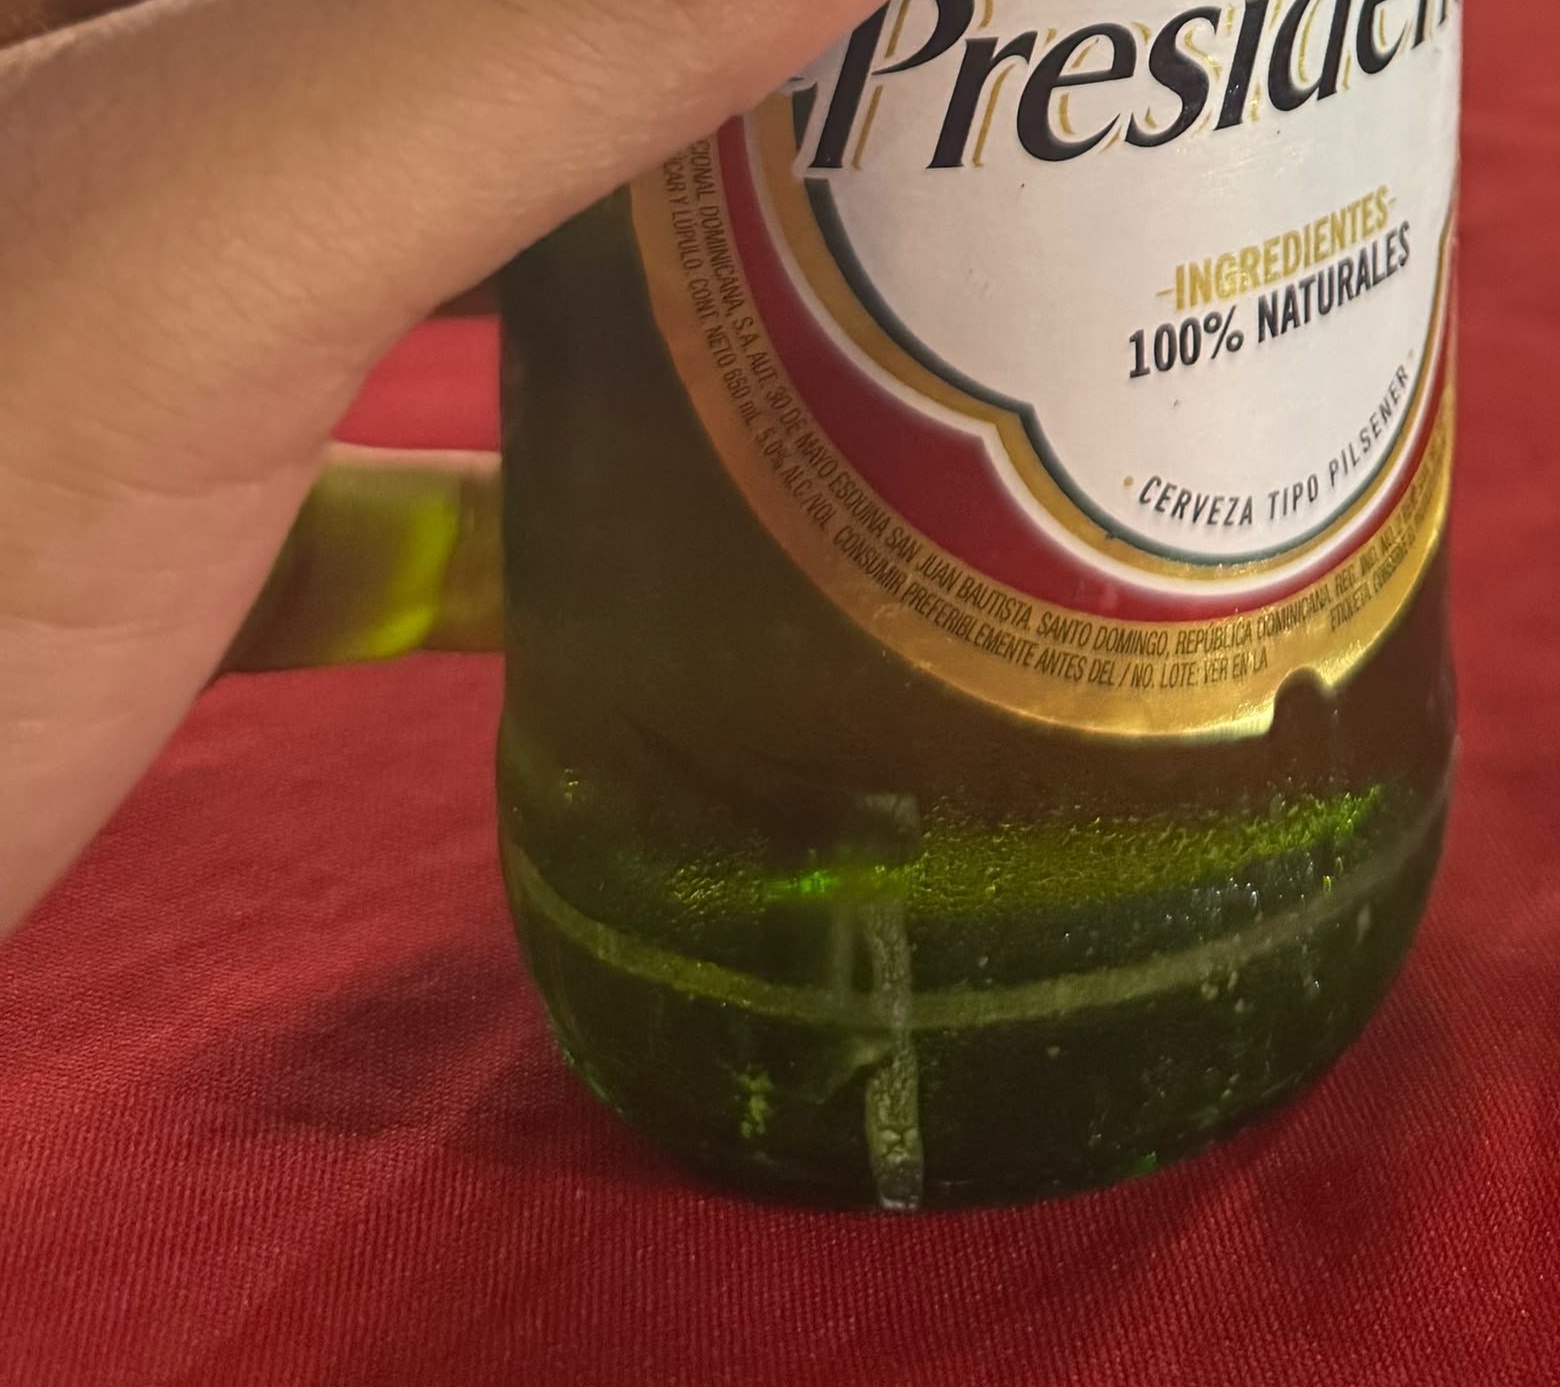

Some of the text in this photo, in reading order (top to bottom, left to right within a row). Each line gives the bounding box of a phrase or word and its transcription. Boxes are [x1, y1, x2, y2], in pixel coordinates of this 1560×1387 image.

[1128, 220, 1411, 378] 100% NATURALES
[765, 385, 793, 410] 30
[780, 407, 807, 436] DE
[669, 195, 689, 206] Y
[706, 325, 737, 369] NETO
[723, 367, 751, 400] 650
[833, 525, 908, 594] CONSUMIR
[900, 582, 1039, 667] PREFERIBLEMENTE
[1034, 648, 1087, 681] ANTES
[1087, 657, 1117, 687] DEL
[1129, 660, 1155, 689] NO.
[1203, 658, 1228, 684] VER
[1232, 651, 1252, 679] EN
[1253, 645, 1268, 673] LA
[793, 431, 839, 478] MAYO
[1138, 474, 1254, 527] CERVEZA
[1267, 474, 1319, 521] TIPO
[1328, 363, 1410, 487] PILSENER
[828, 471, 892, 539] ESQUINA
[886, 528, 921, 563] SAN
[917, 554, 962, 593] JUAN
[1036, 610, 1092, 647] SANTO
[1093, 626, 1169, 659] DOMINGO,
[1175, 620, 1252, 655] REPÚBLICA
